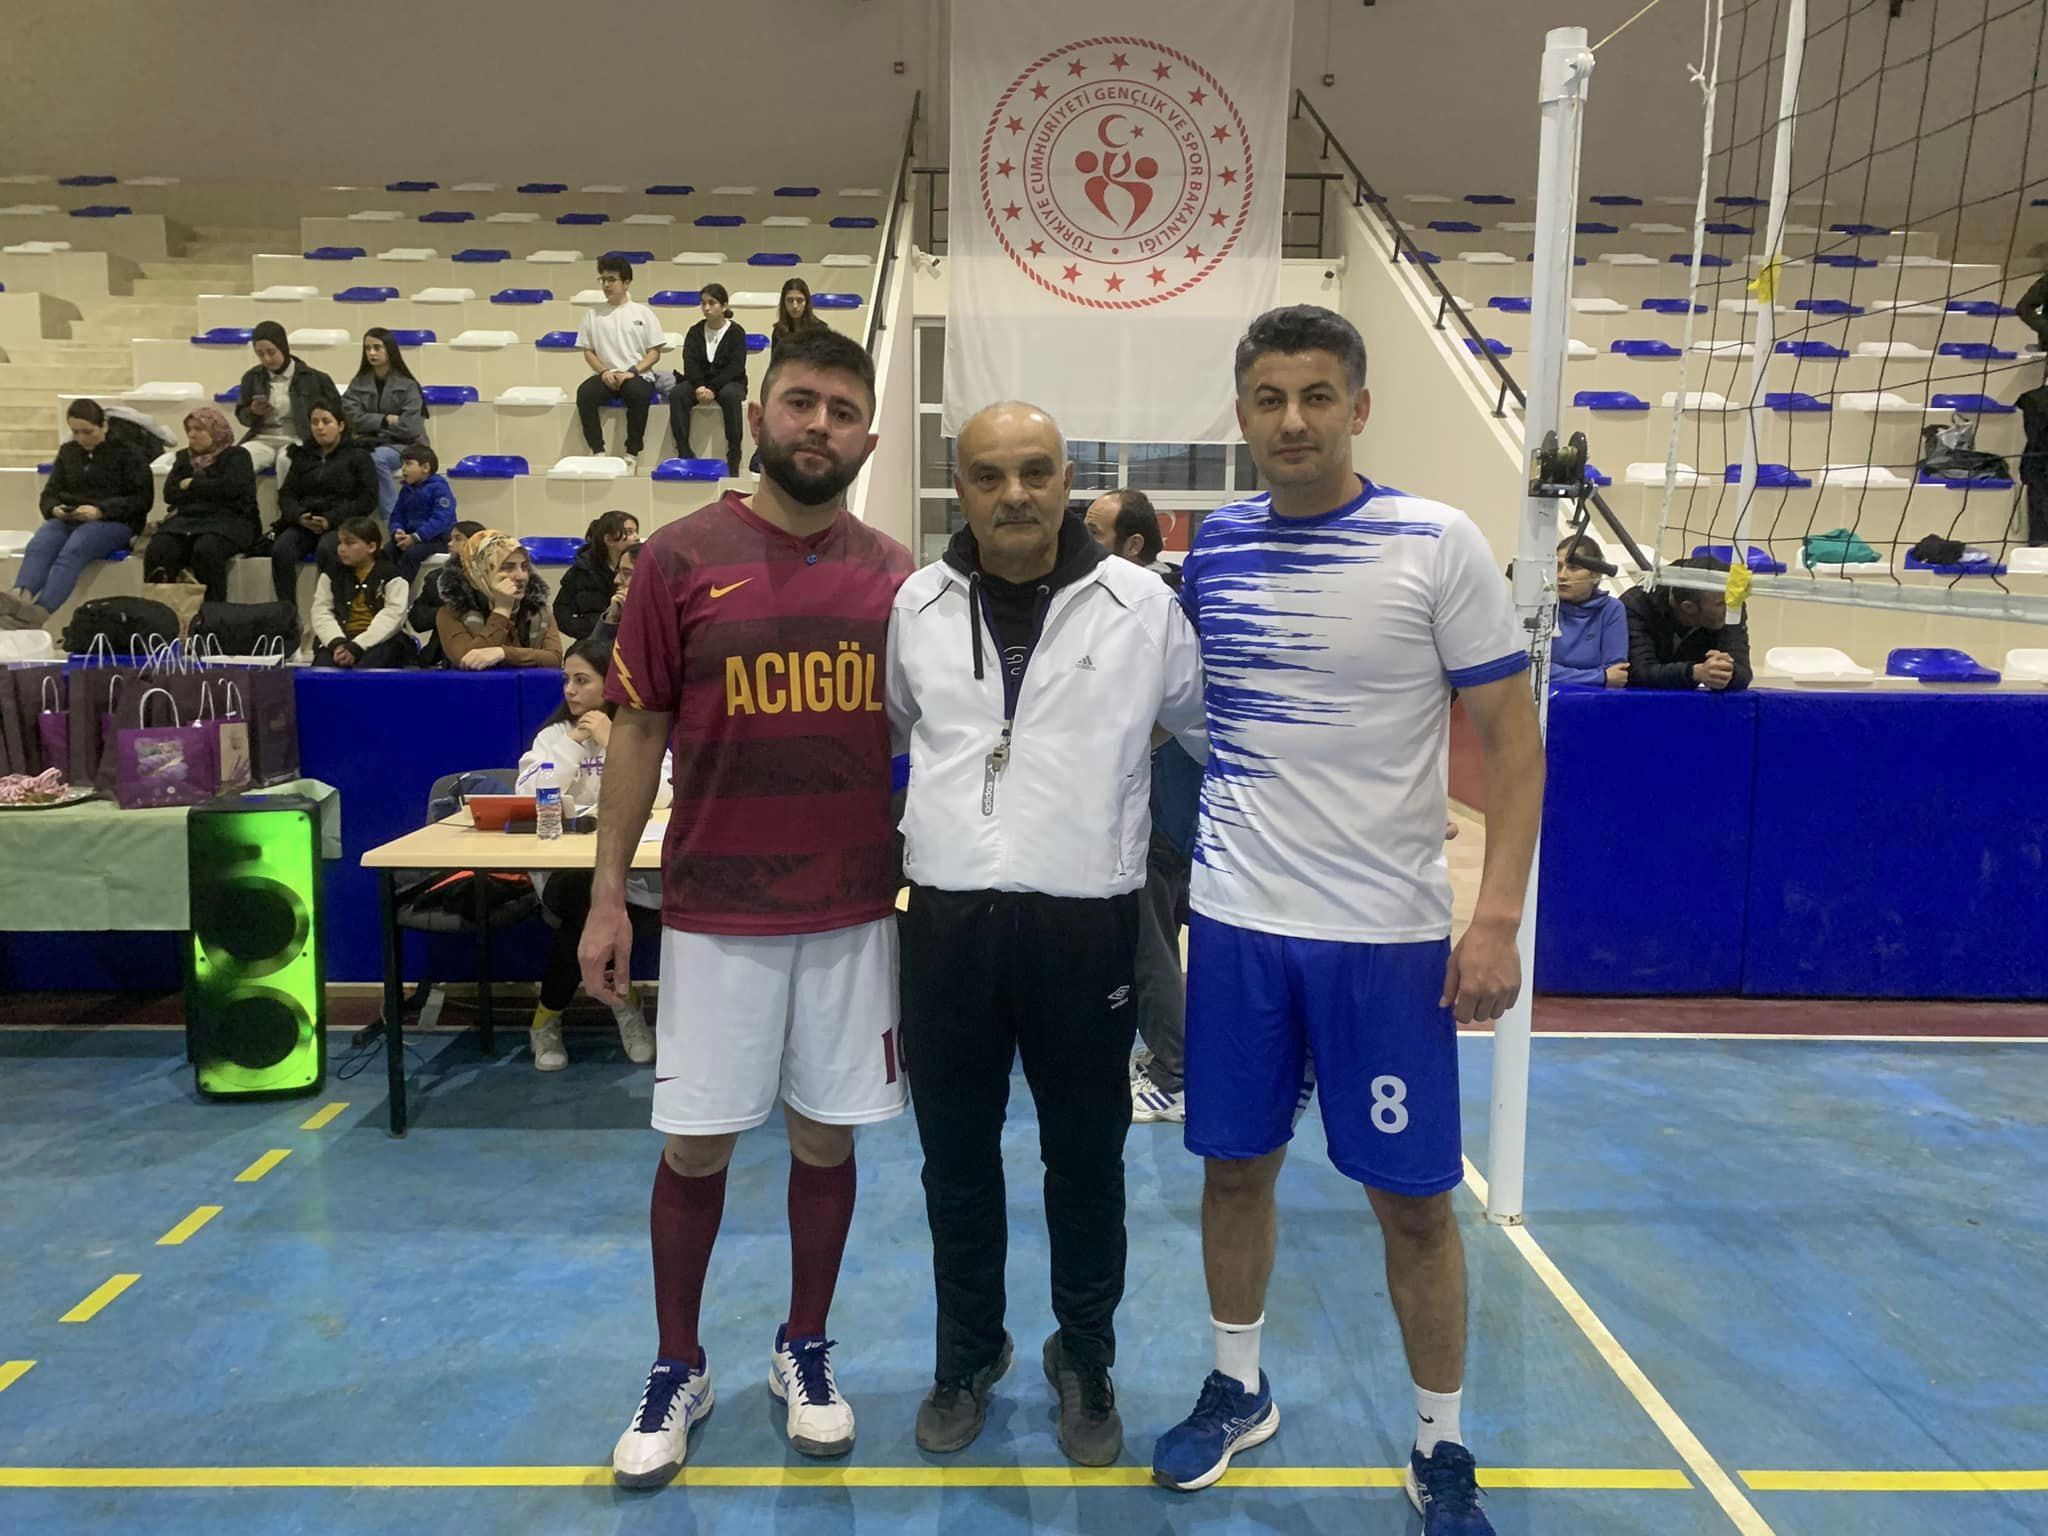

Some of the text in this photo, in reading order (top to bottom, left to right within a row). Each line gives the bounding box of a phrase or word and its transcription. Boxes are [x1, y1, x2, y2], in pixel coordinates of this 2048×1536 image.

[1031, 86, 1203, 254] TÜRKİYE CUMHURİYETİ GENÇLİK VE SPOR BAKANLIĞI
[726, 640, 883, 716] ACIGÖL
[1370, 1074, 1409, 1134] 8
